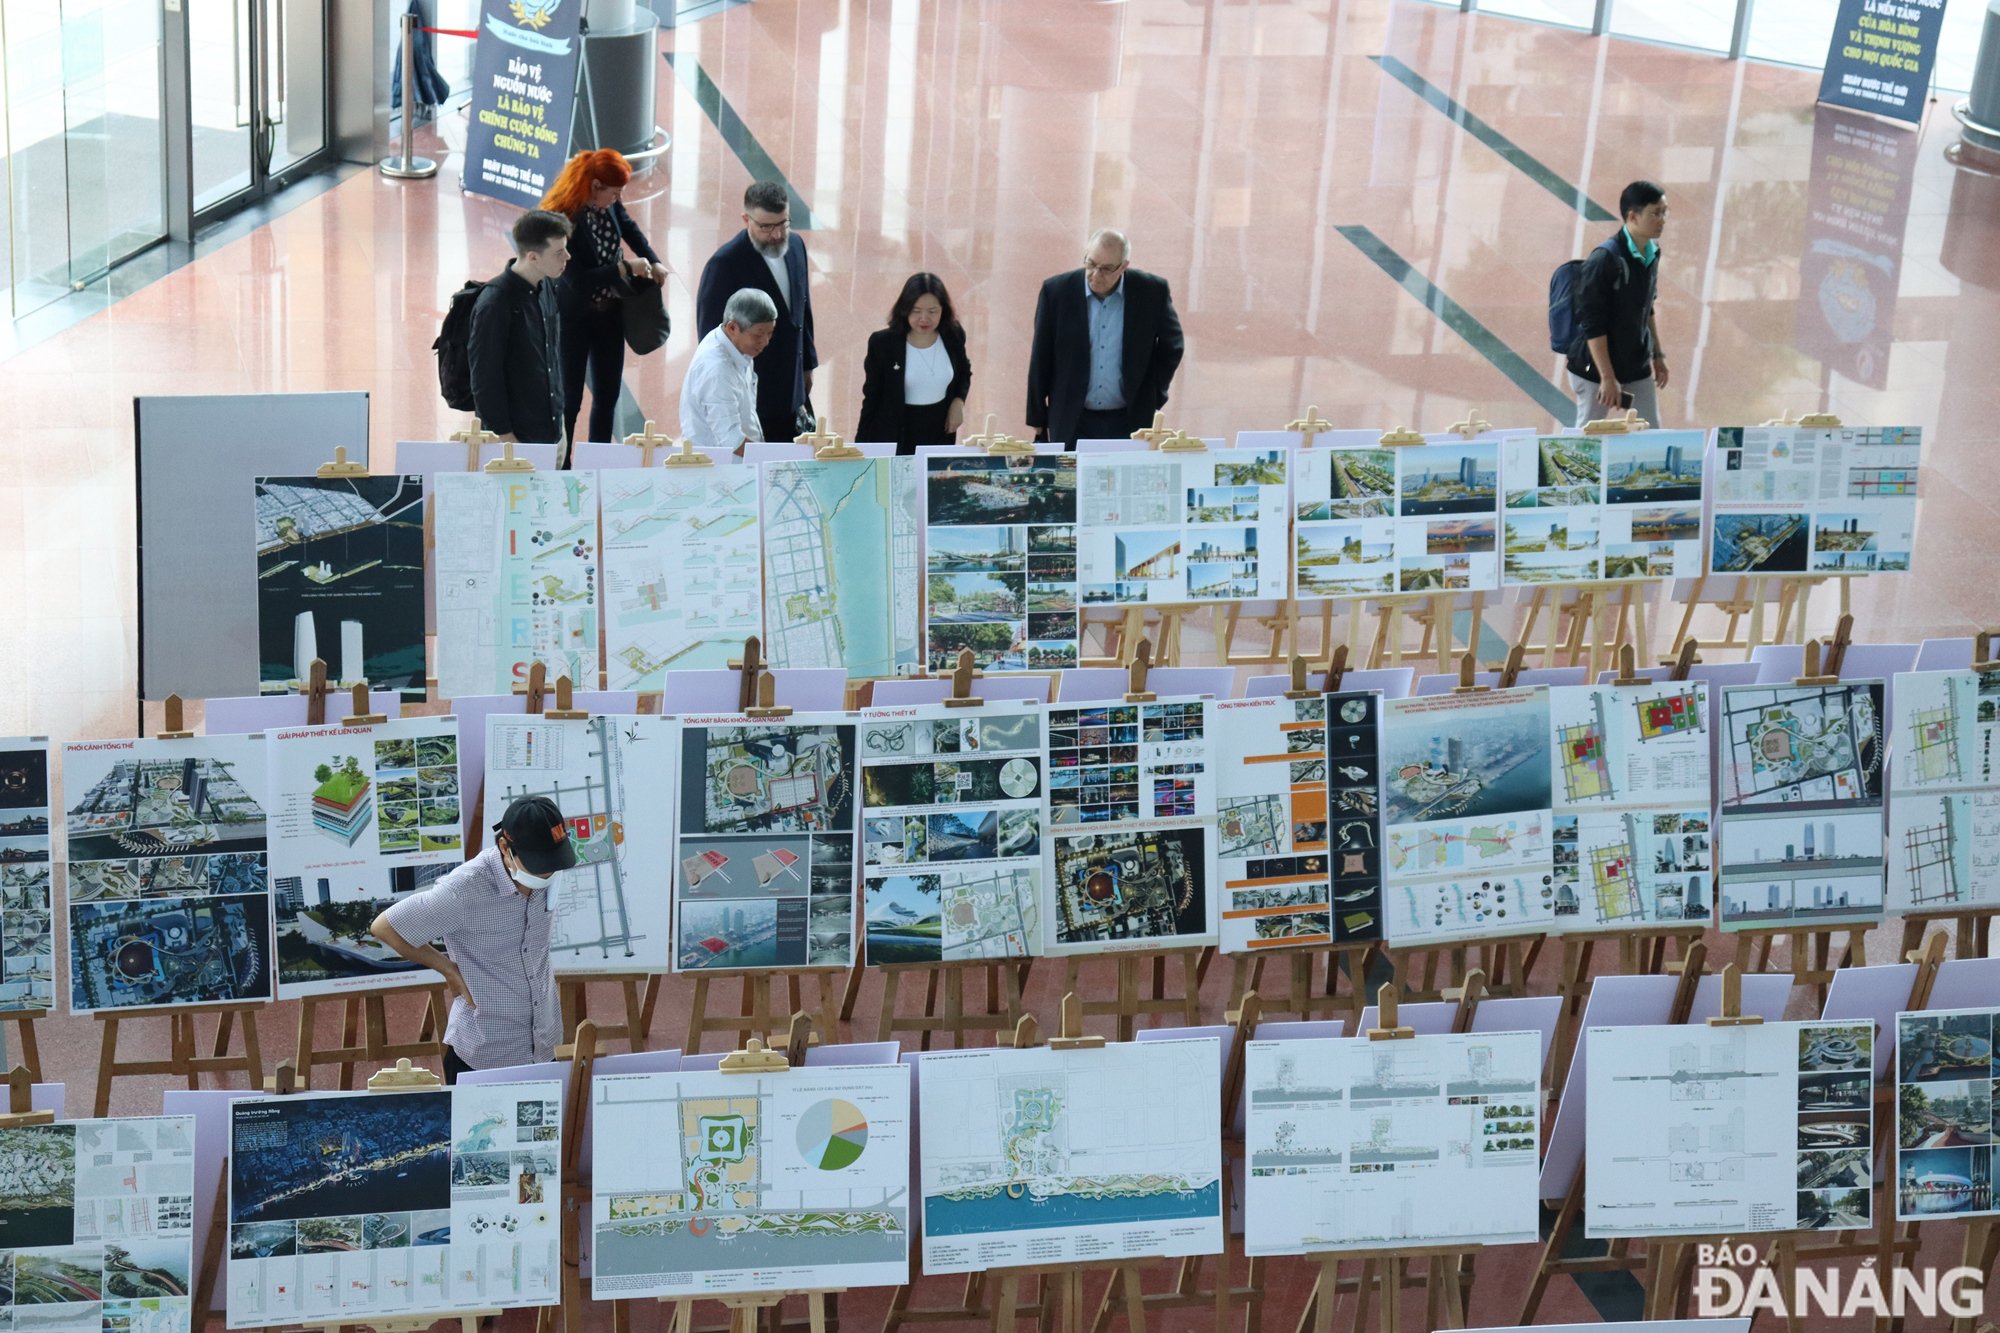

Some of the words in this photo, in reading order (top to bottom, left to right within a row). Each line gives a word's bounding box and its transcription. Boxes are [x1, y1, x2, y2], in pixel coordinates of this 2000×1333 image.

[1850, 29, 1862, 43] VÀ
[508, 56, 528, 76] BẢO
[529, 63, 542, 84] VỆ
[1843, 45, 1862, 60] CHO
[1880, 52, 1904, 69] QUỐC
[1904, 58, 1919, 73] GIA
[493, 74, 526, 95] NGUỒN
[527, 83, 553, 104] NƯỚC
[497, 94, 510, 111] LÀ
[512, 97, 531, 116] BẢO
[532, 104, 544, 123] VỆ
[479, 110, 509, 130] CHÍNH
[509, 119, 534, 138] CUỘC
[534, 123, 558, 145] SỐNG
[494, 133, 526, 154] CHÚNG
[528, 143, 540, 159] TA
[67, 743, 83, 751] PHỐI
[84, 743, 102, 751] CẢNH
[102, 742, 121, 750] TỔNG
[277, 731, 291, 740] GIẢI
[291, 730, 309, 739] PHÁP
[310, 728, 327, 737] THIẾT
[328, 727, 337, 736] KẾ
[337, 726, 352, 735] LIÊN
[352, 727, 372, 735] QUAN
